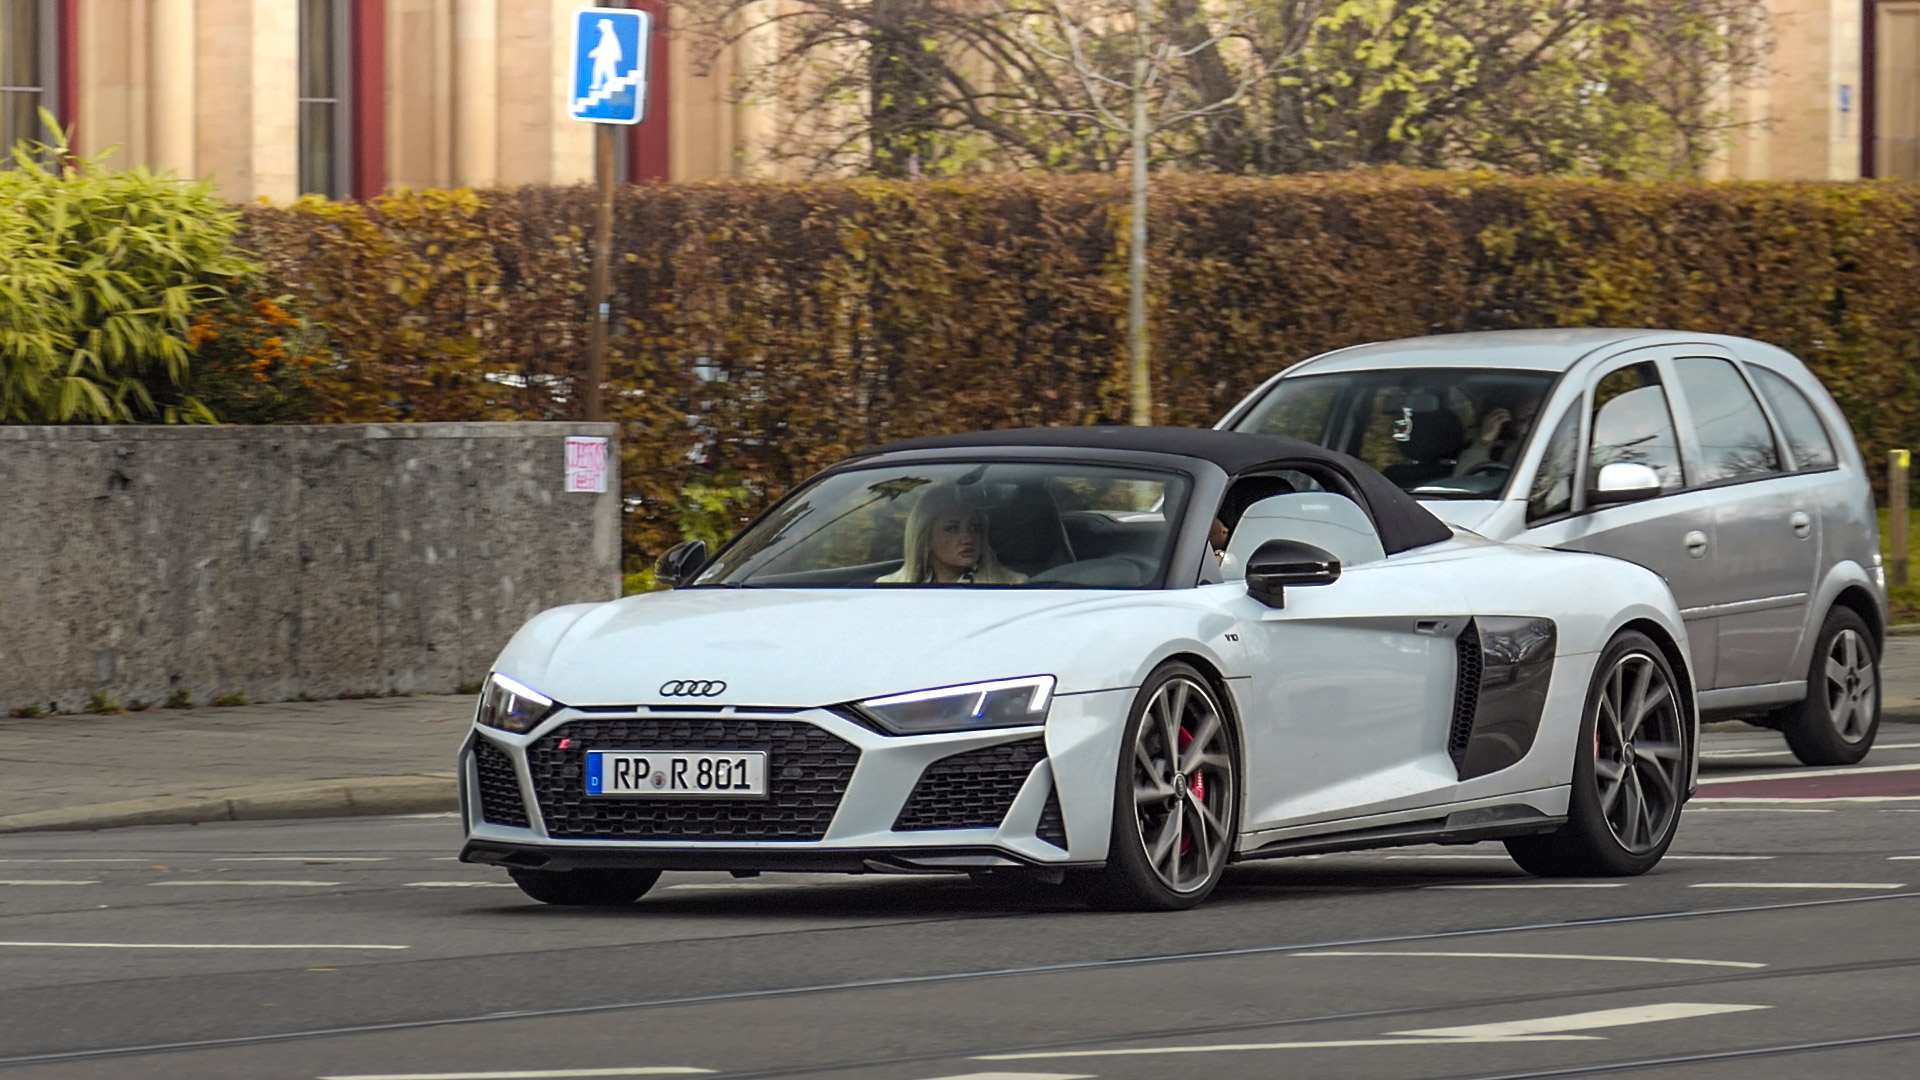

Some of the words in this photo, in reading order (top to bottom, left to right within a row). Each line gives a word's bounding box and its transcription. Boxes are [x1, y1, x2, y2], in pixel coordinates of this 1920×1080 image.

[591, 776, 598, 787] D
[614, 758, 651, 790] RP
[671, 758, 689, 790] R
[696, 758, 751, 790] 801
